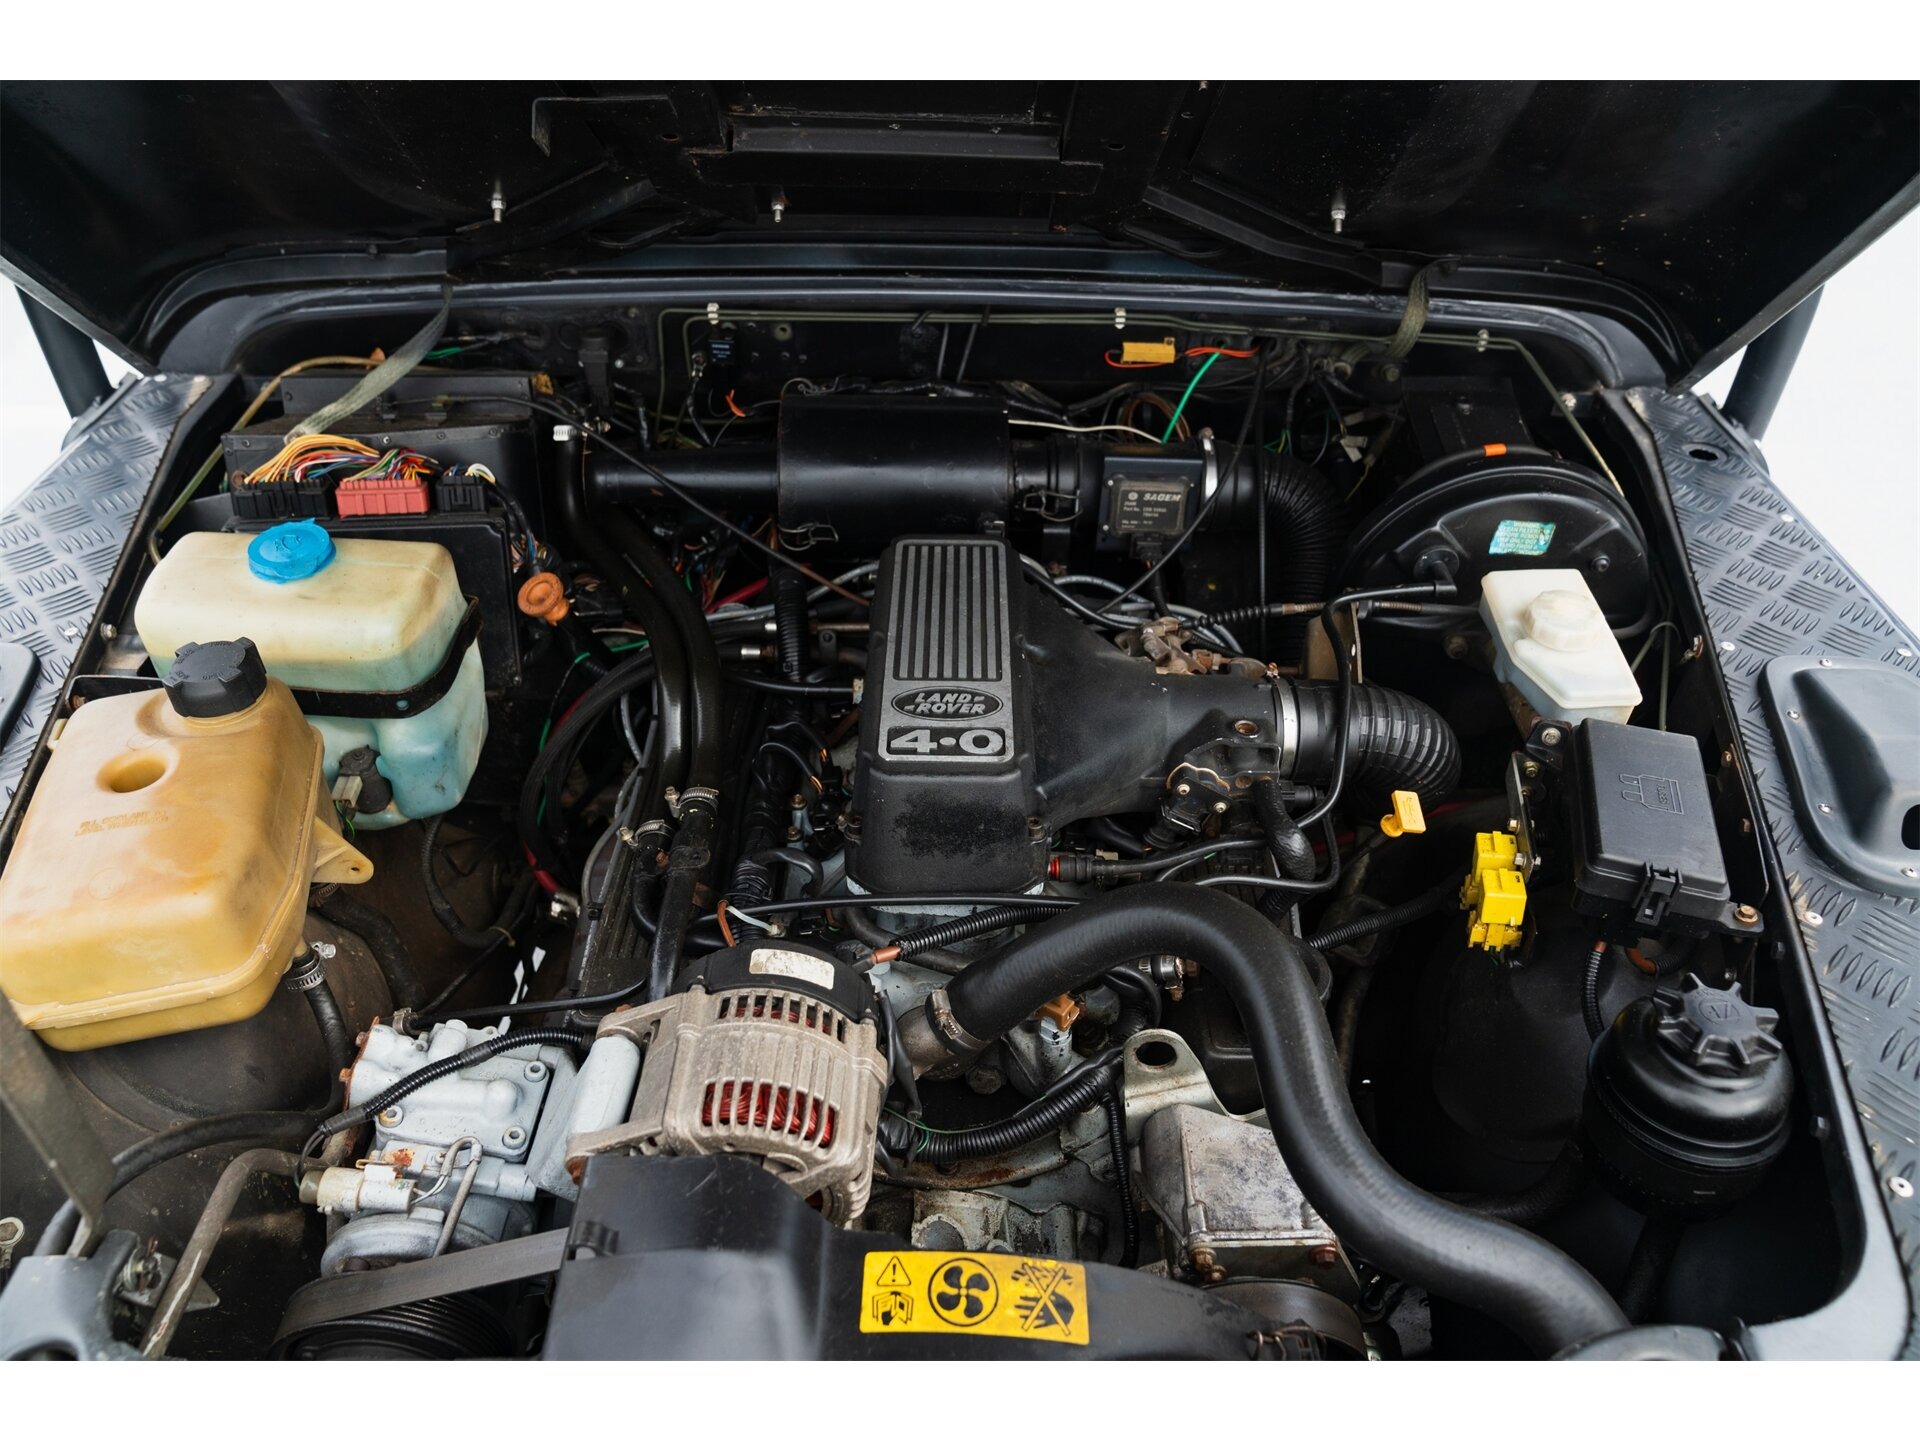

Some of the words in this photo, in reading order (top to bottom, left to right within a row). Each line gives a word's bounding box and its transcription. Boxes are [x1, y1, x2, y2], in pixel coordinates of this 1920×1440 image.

[1143, 492, 1182, 502] SAGEM
[914, 692, 972, 704] LAND
[914, 703, 986, 714] ROVER
